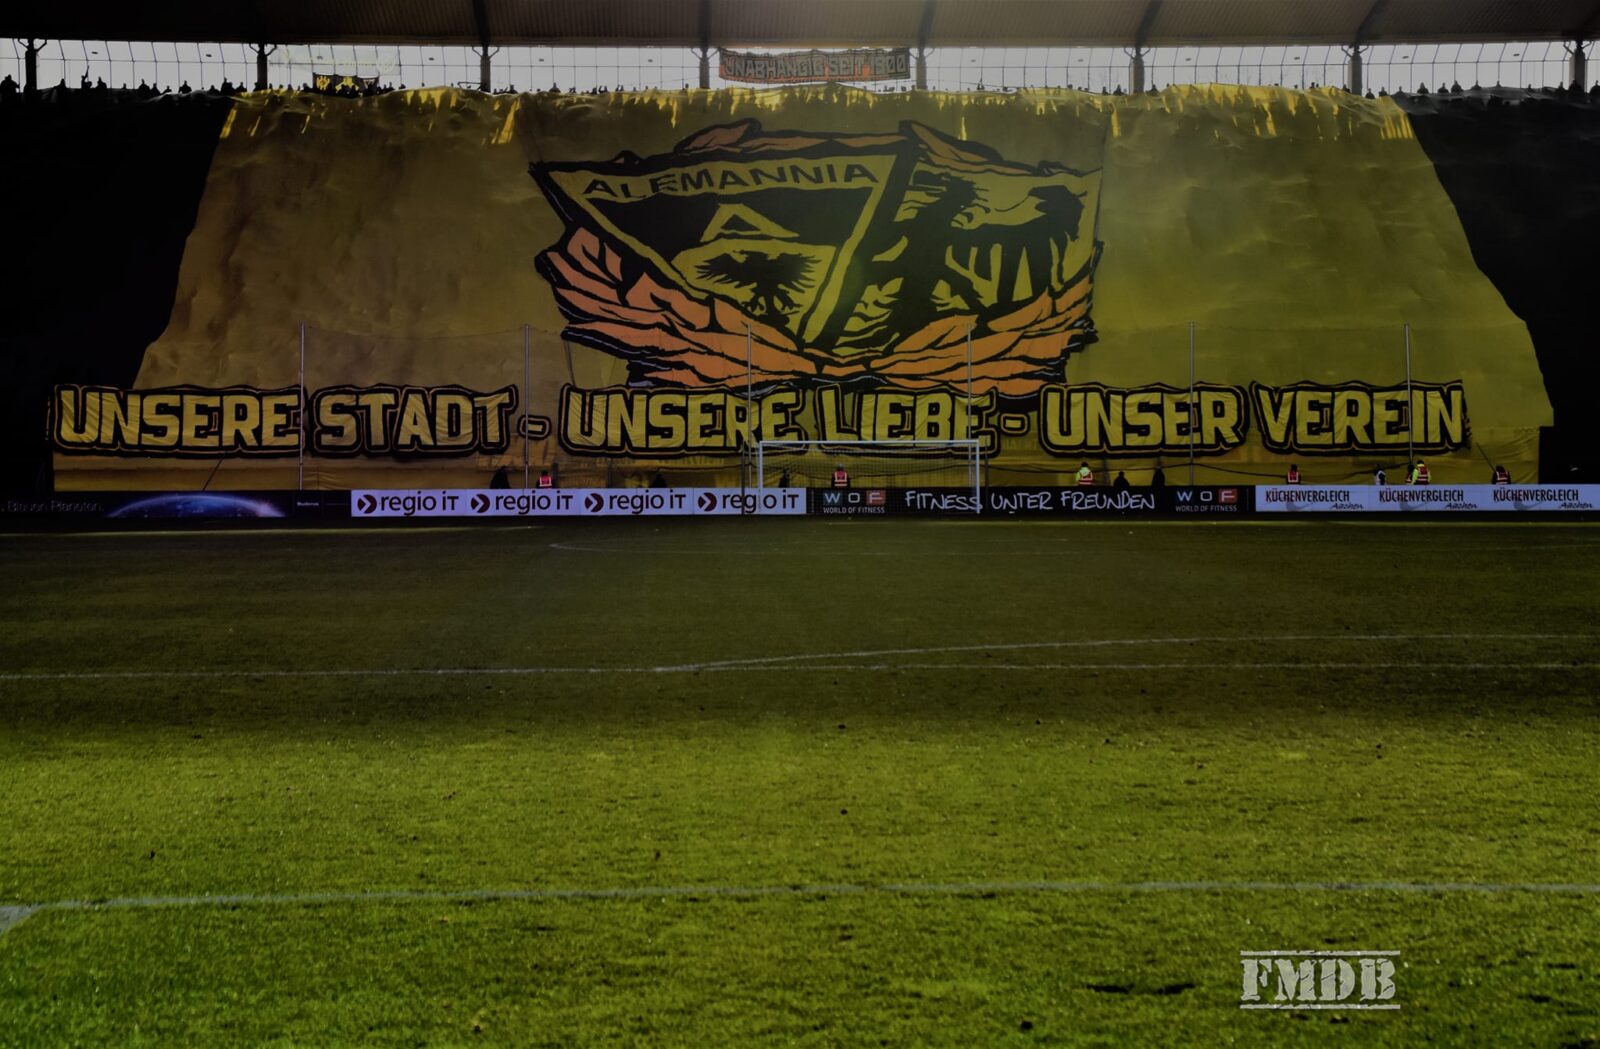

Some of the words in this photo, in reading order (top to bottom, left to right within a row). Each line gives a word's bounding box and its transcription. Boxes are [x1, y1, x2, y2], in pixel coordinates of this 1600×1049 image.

[828, 56, 866, 76] SEIT
[583, 163, 879, 199] ALEMANNIA
[56, 386, 303, 453] UNSERE
[315, 386, 513, 453] STADT
[563, 386, 803, 453] UNSERE
[818, 386, 996, 453] LIEBE
[1043, 387, 1245, 452] UNSER
[1255, 386, 1467, 452] VEREIN
[381, 491, 437, 515] regio
[495, 490, 550, 514] regio
[609, 490, 664, 514] regio
[722, 491, 777, 513] rego
[905, 490, 983, 511] FITNESS
[991, 492, 1053, 511] UNTER
[1060, 490, 1155, 511] FREUNDEN
[1265, 489, 1350, 502] KÜCHENVERGLEICH
[1379, 488, 1464, 502] KÜCHENVERGLEICH
[1493, 487, 1579, 501] KÜCHENVERGLEICH
[823, 506, 847, 514] WORLD
[848, 506, 856, 514] OF
[857, 506, 886, 514] FITNESS
[1330, 502, 1364, 510] Aachen
[1558, 501, 1593, 509] Aachen
